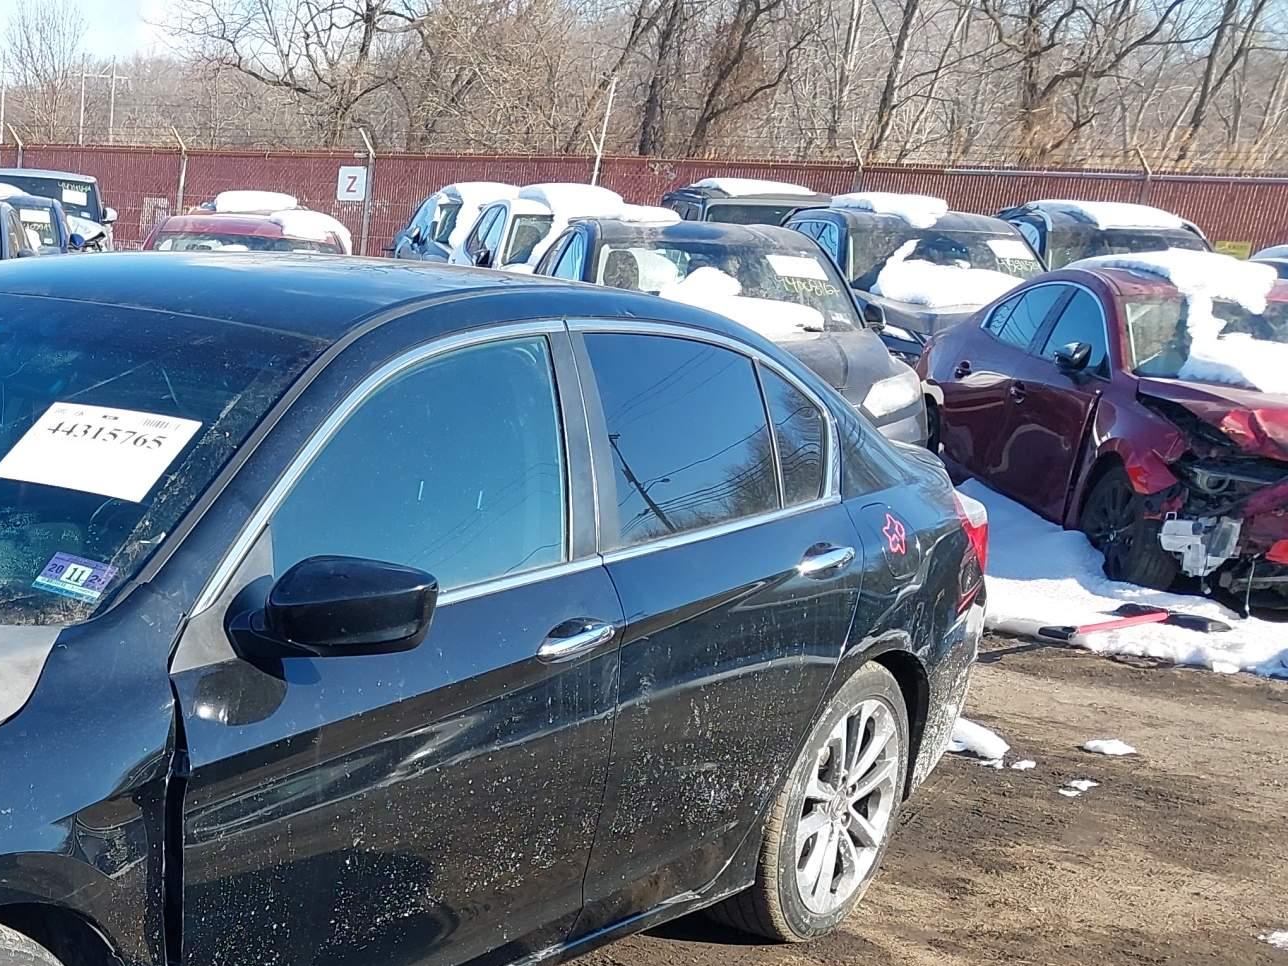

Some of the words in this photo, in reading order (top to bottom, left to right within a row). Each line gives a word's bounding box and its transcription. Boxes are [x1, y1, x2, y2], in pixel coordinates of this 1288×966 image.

[345, 175, 358, 193] Z
[47, 420, 168, 450] 44315765
[47, 563, 65, 575] 20
[65, 566, 86, 584] 11
